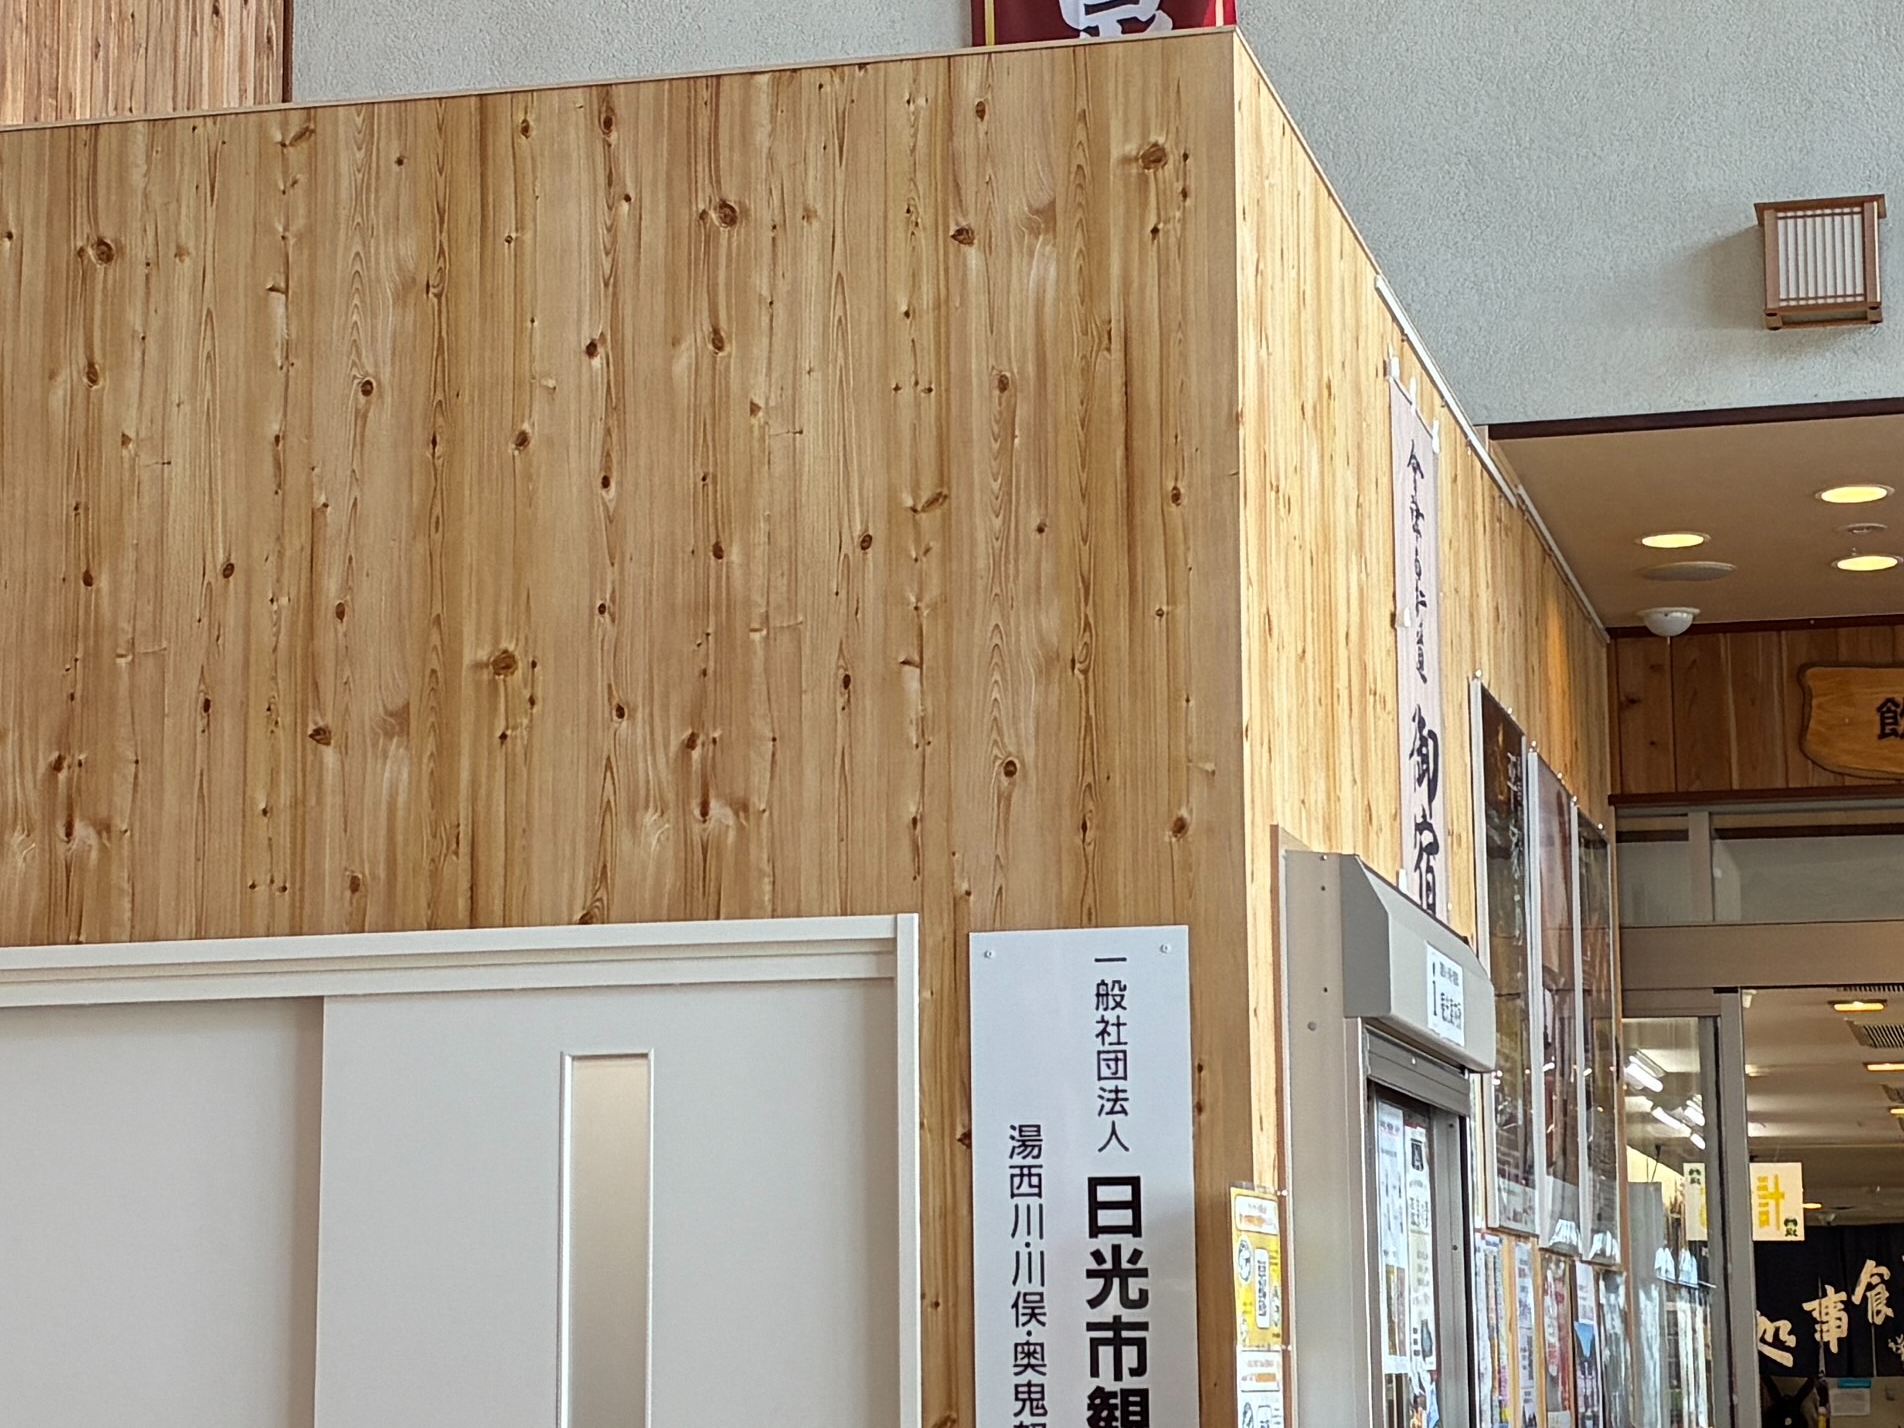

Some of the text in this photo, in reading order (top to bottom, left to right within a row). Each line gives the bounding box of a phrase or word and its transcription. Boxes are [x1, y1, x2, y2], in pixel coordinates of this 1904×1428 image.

[1092, 955, 1131, 1153] 一般社団法人
